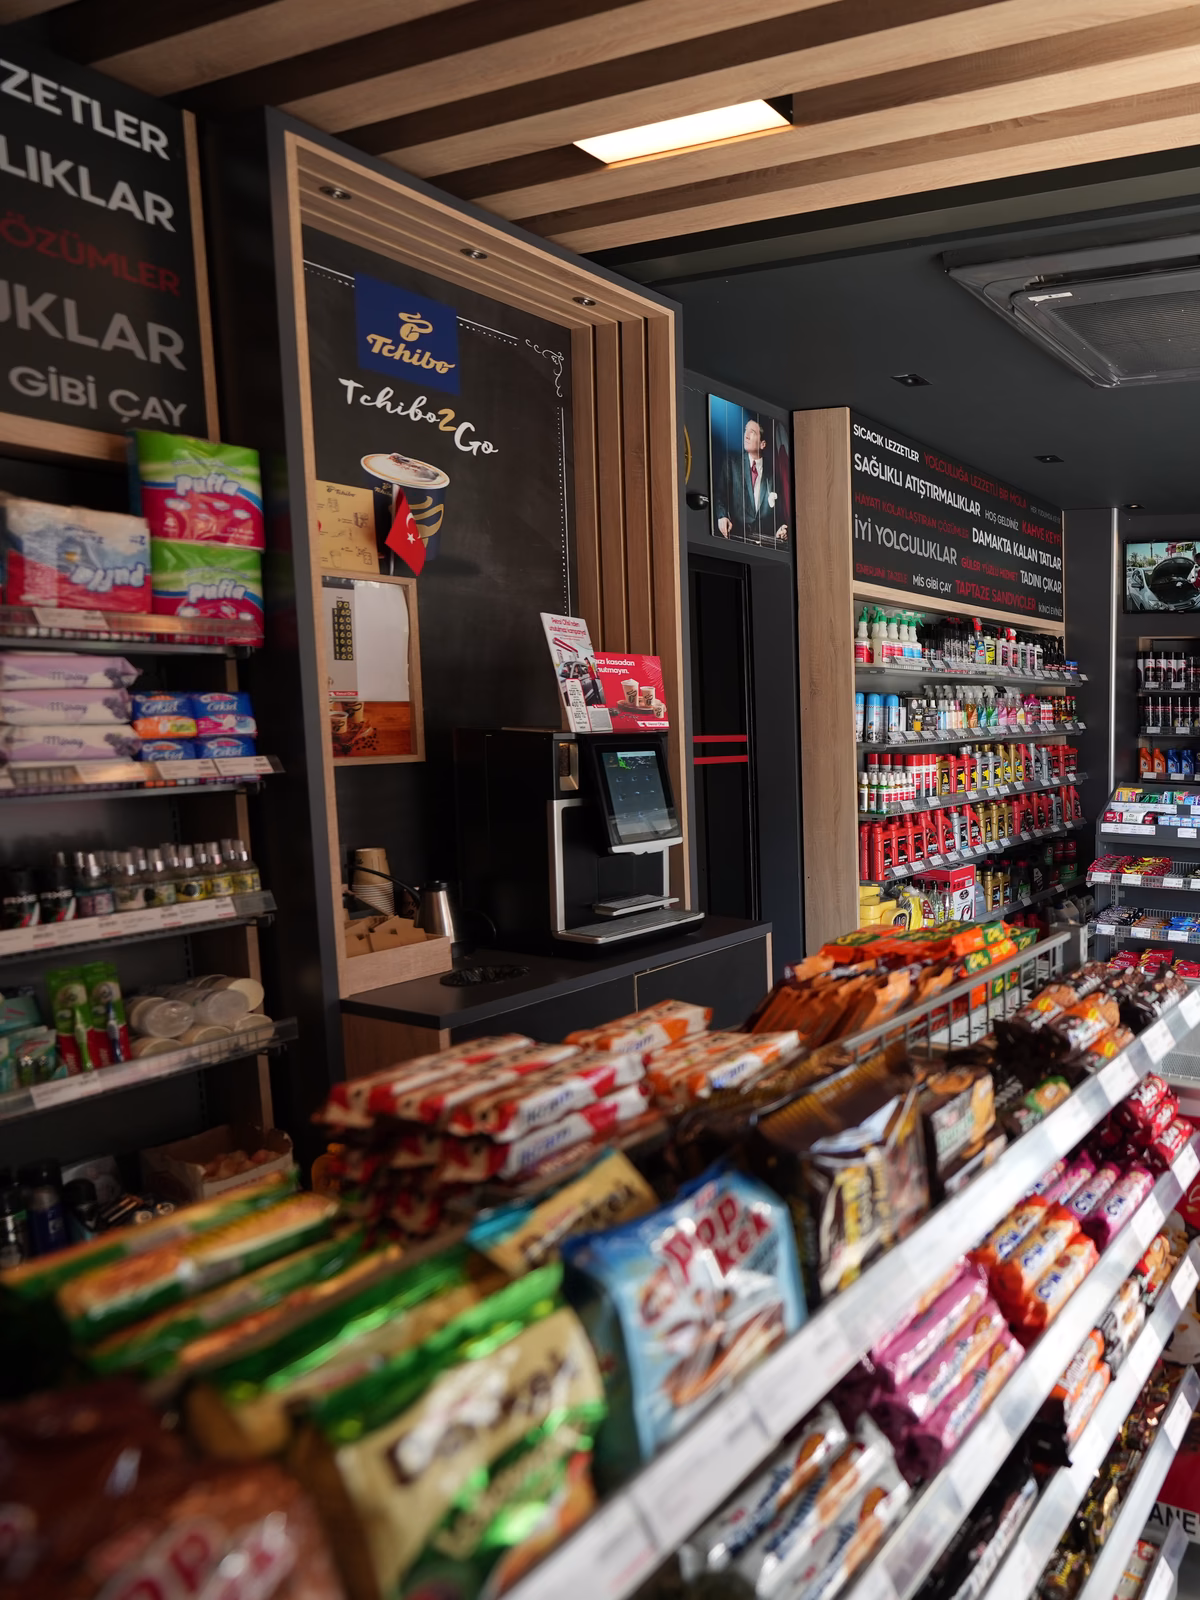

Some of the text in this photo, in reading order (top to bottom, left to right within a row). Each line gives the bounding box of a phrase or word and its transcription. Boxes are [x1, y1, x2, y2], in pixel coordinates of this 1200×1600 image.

[0, 59, 169, 160] ZETLER
[366, 334, 455, 374] Tchibo
[9, 365, 187, 427] GİBİ ÇAY
[853, 424, 884, 447] SICACIK
[884, 438, 919, 462] LEZZETLER
[854, 453, 902, 486] SAĞLIKLI
[905, 474, 981, 516] ATIŞTIRMALIKLAR
[985, 510, 997, 525] HOŞ
[997, 513, 1018, 530] GELDİNİZ
[1022, 520, 1044, 541] KAHVE
[854, 513, 872, 542] İYİ
[875, 525, 957, 565] YOLCULUKLAR
[1020, 570, 1041, 588] TADINI
[1043, 576, 1062, 593] ÇIKAR
[972, 527, 1012, 554] DAMAKTA
[1013, 541, 1038, 563] KALAN
[1039, 551, 1062, 571] TATLAR
[912, 574, 924, 587] MİS
[925, 577, 938, 589] GİBİ
[939, 580, 952, 593] ÇAY
[955, 579, 989, 600] TAPTAZE
[606, 658, 635, 667] kasadan
